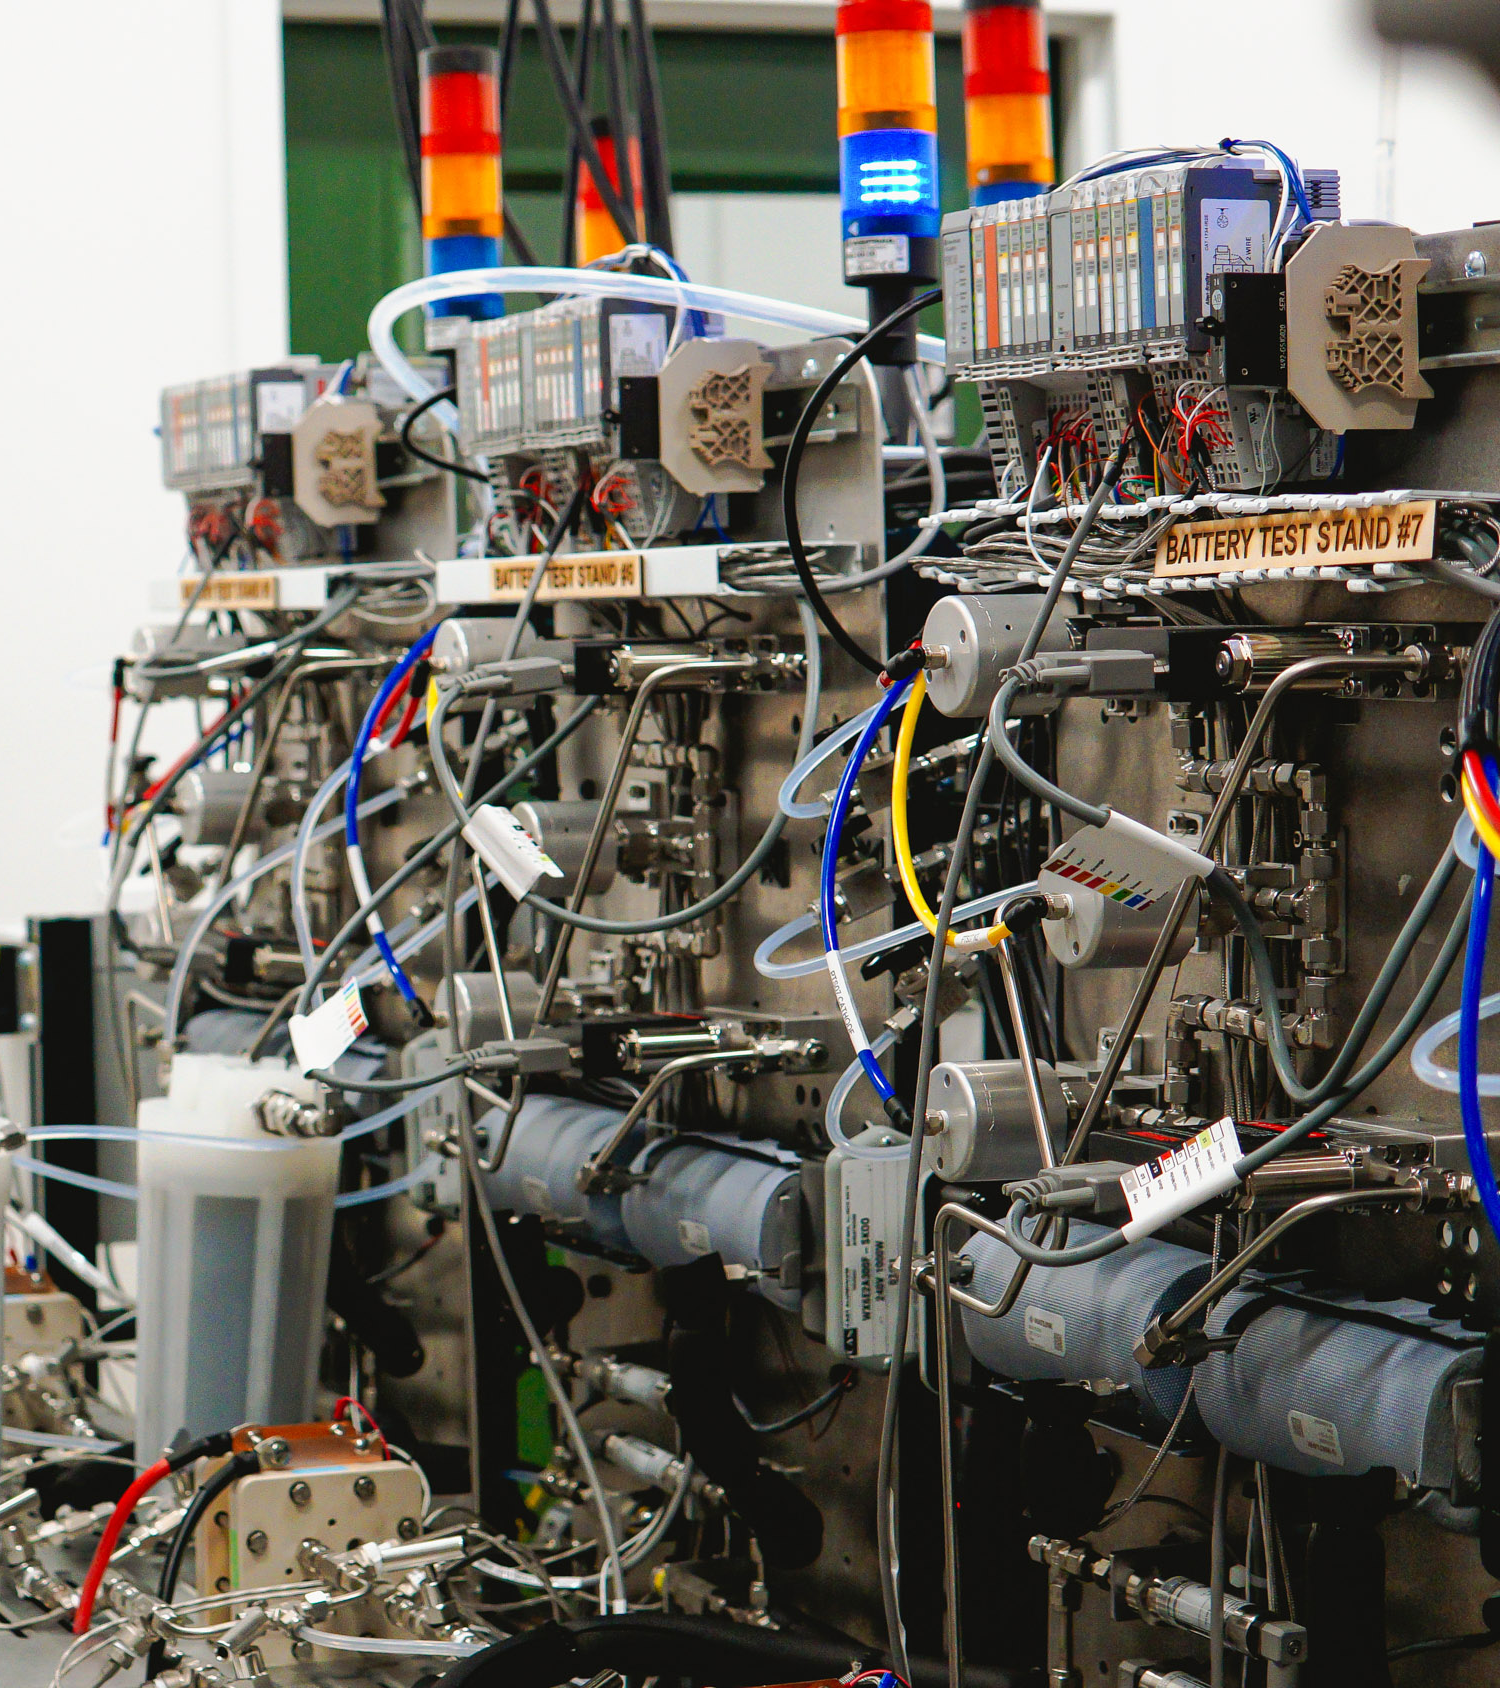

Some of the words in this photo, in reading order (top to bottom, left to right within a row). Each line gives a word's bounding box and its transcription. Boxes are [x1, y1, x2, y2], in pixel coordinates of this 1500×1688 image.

[1166, 528, 1254, 565] BATTERY
[1260, 523, 1312, 558] TEST
[1317, 516, 1390, 553] STAND
[1397, 513, 1423, 548] #7
[494, 566, 537, 590] BATTER
[546, 564, 574, 588] TEST
[577, 562, 617, 587] STAND
